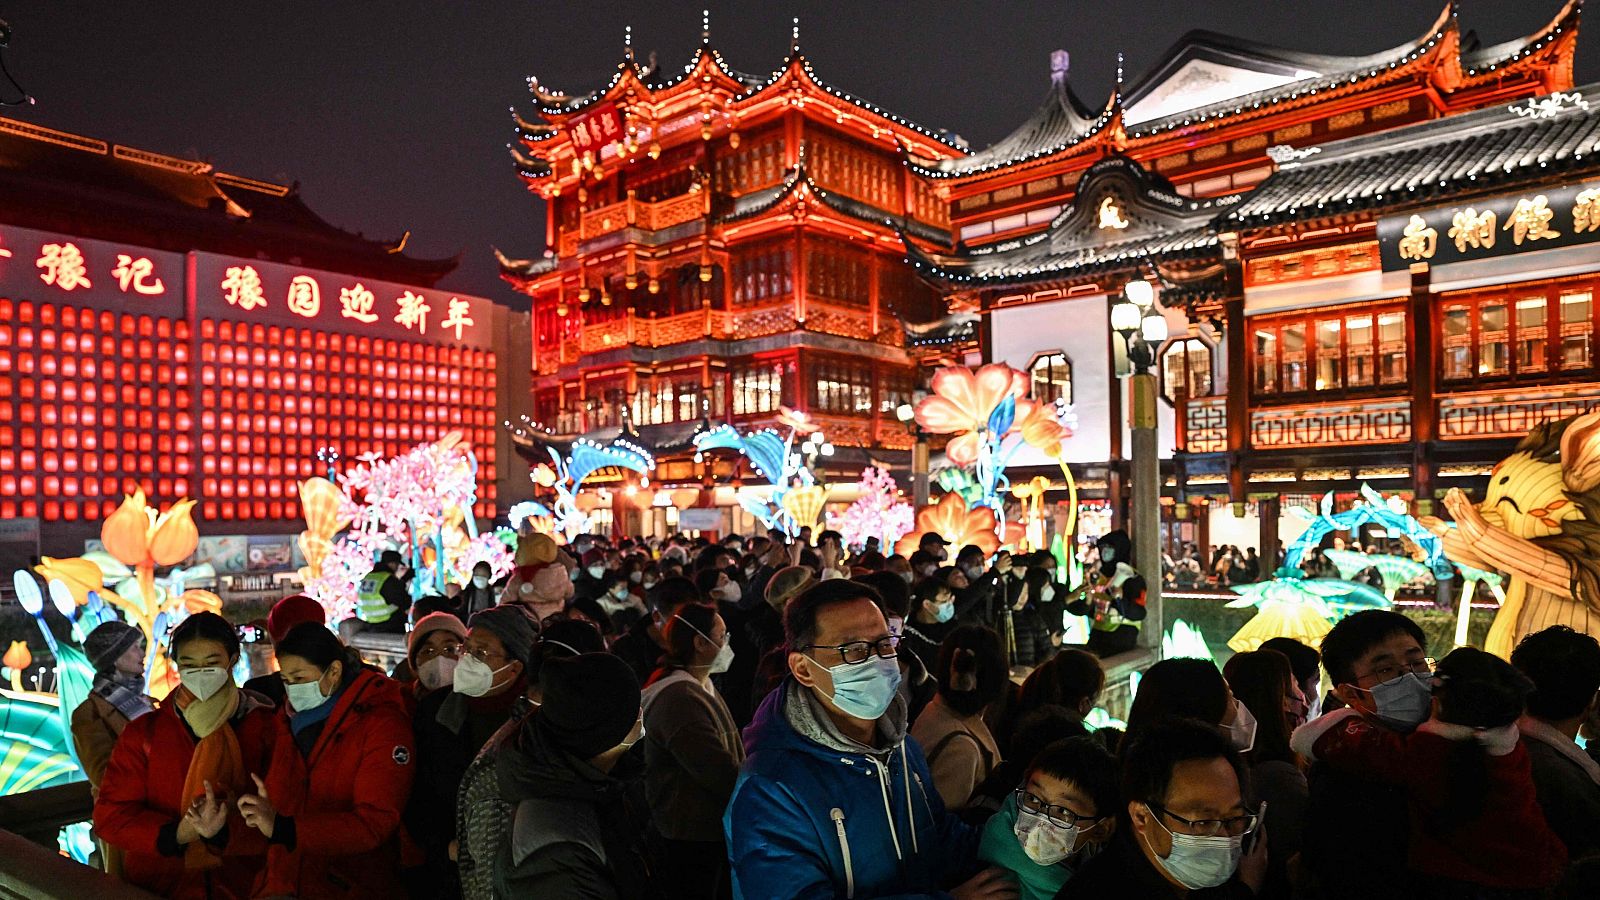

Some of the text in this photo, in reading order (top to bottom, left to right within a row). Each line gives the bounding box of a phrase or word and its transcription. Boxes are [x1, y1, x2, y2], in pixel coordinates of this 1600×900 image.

[0, 242, 165, 294] 豫记
[221, 265, 475, 341] 豫园迎新年
